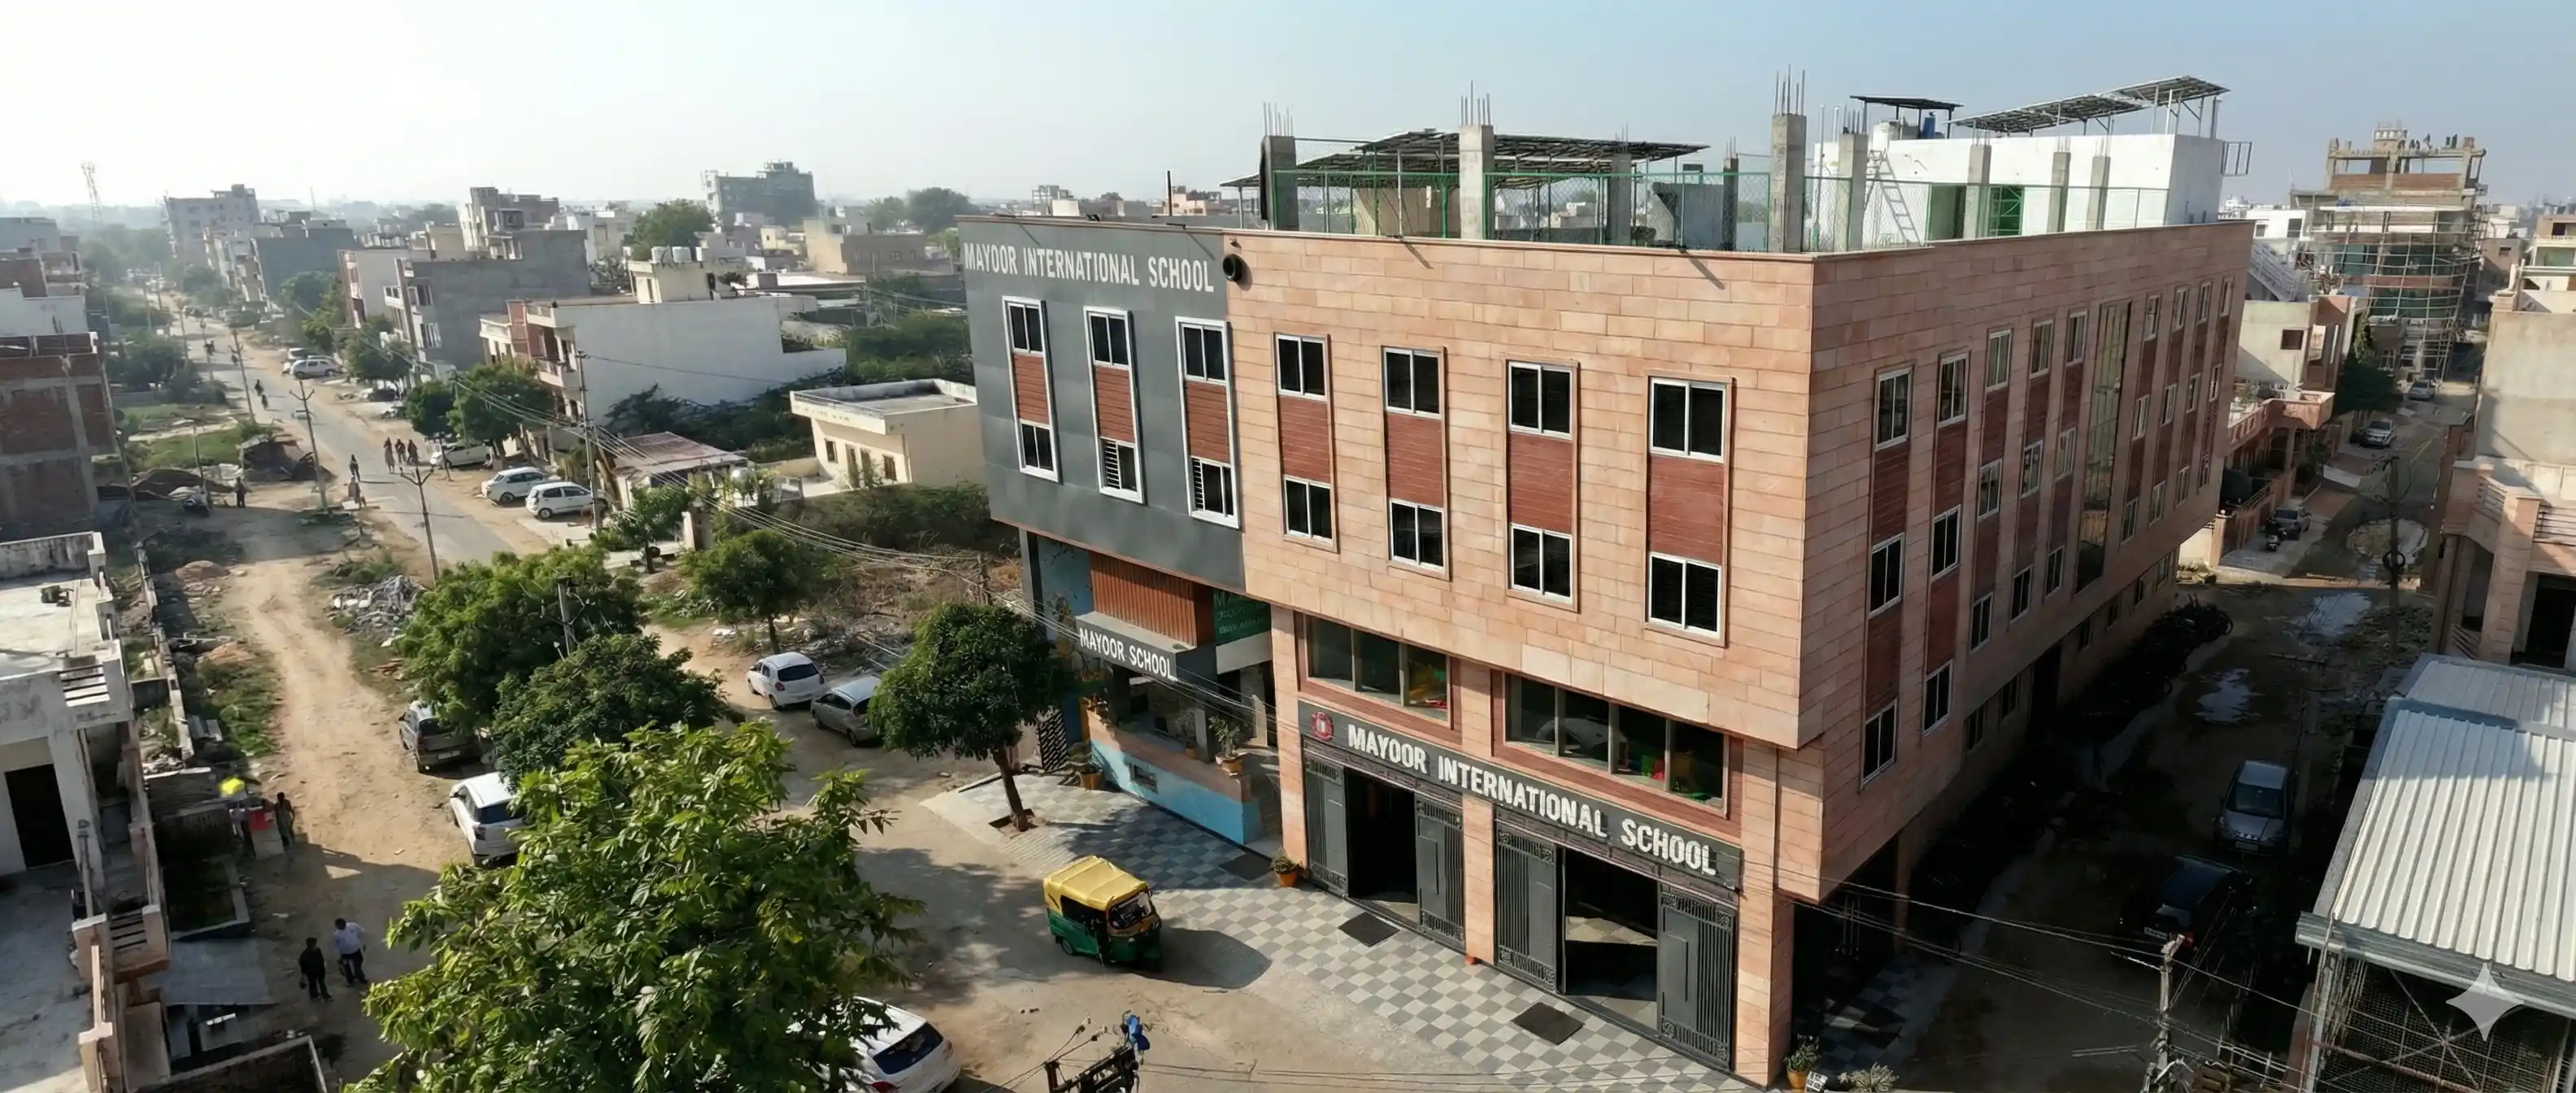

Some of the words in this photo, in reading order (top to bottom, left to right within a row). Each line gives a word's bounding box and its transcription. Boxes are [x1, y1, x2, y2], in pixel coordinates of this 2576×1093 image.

[964, 242, 1018, 275] MAYOOR
[1023, 246, 1140, 285] INTERNATIONAL
[1147, 256, 1214, 293] SCHOOL
[1079, 627, 1125, 661] MAYOOR
[1128, 644, 1175, 681] SCHOOL
[1347, 723, 1427, 774] MAYOOR
[1438, 755, 1608, 839] INTERNATIONAL
[1620, 817, 1717, 877] SCHOOL
